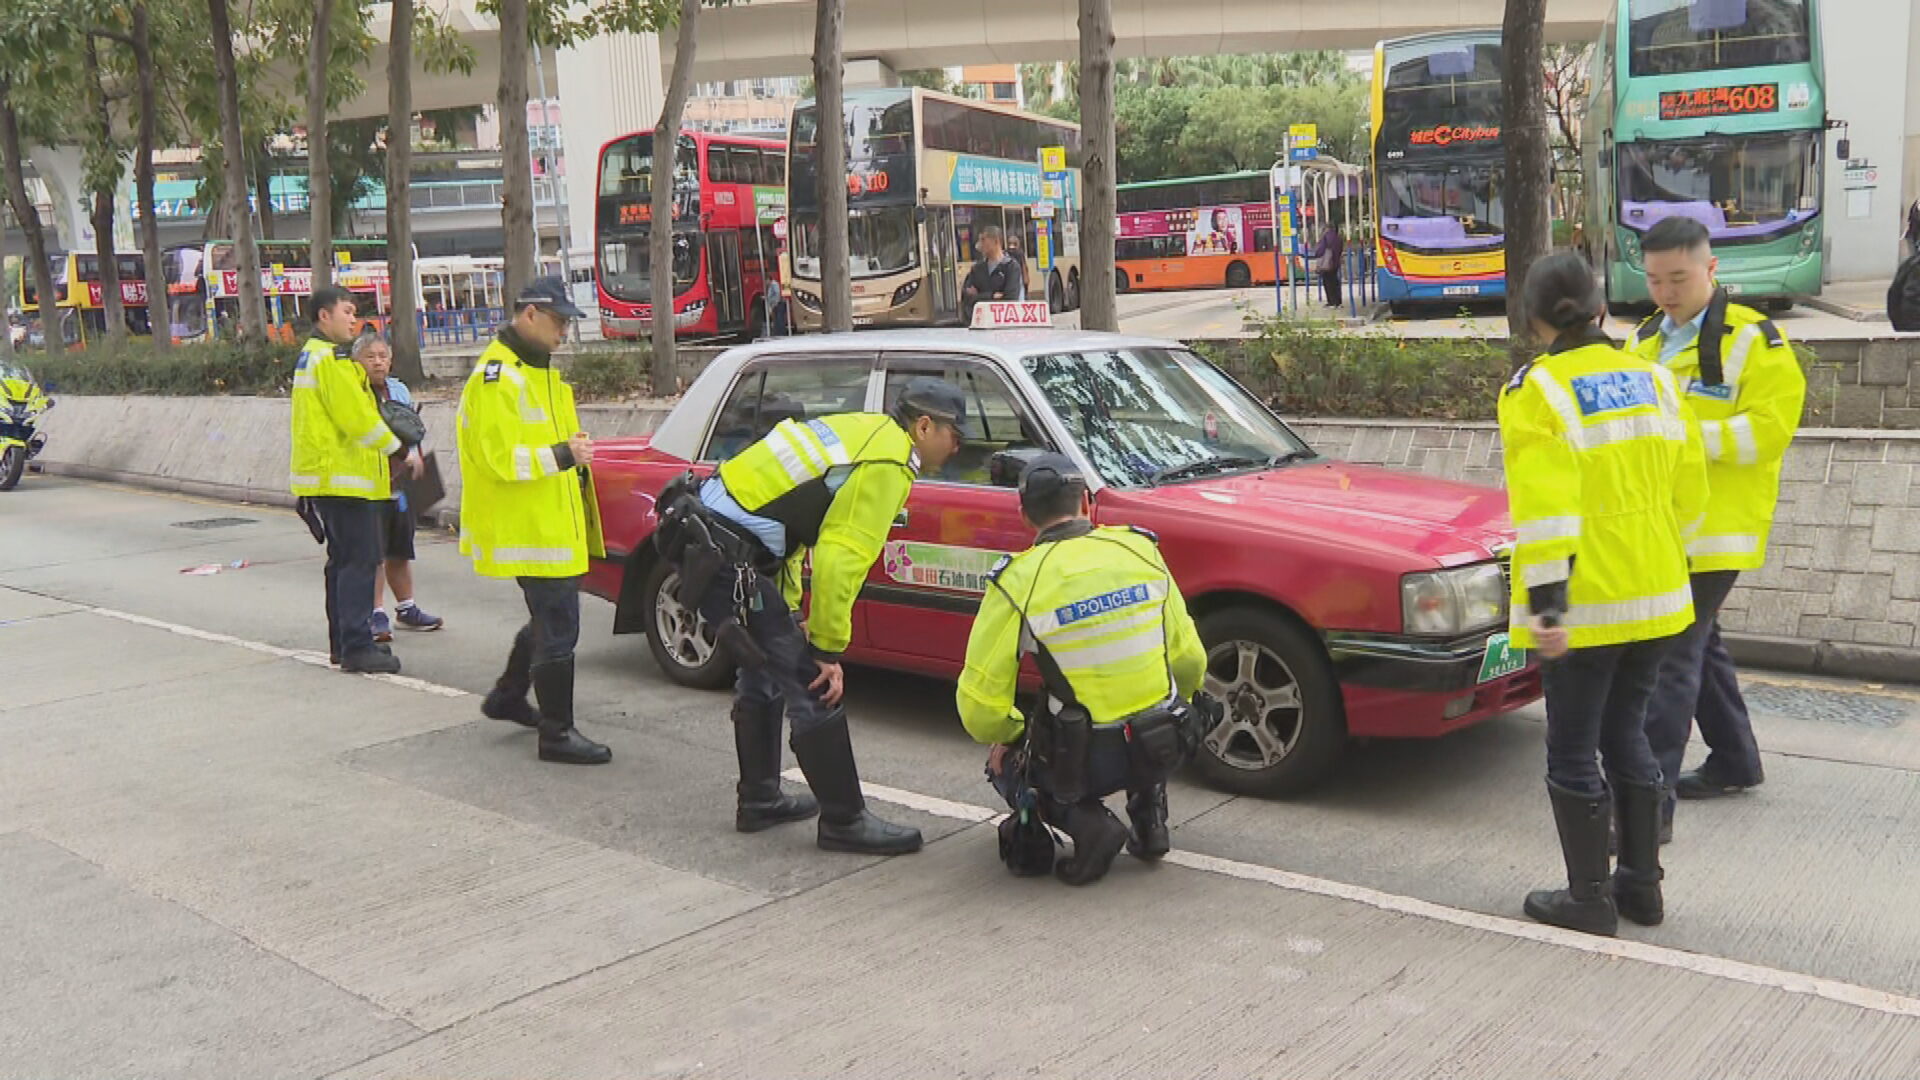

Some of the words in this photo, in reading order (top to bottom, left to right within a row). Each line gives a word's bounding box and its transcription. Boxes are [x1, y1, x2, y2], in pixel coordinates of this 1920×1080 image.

[1728, 85, 1775, 110] 608
[1451, 126, 1499, 141] Citybus
[991, 303, 1047, 322] TAXI
[1079, 589, 1131, 617] POLICE
[1500, 643, 1509, 661] 4
